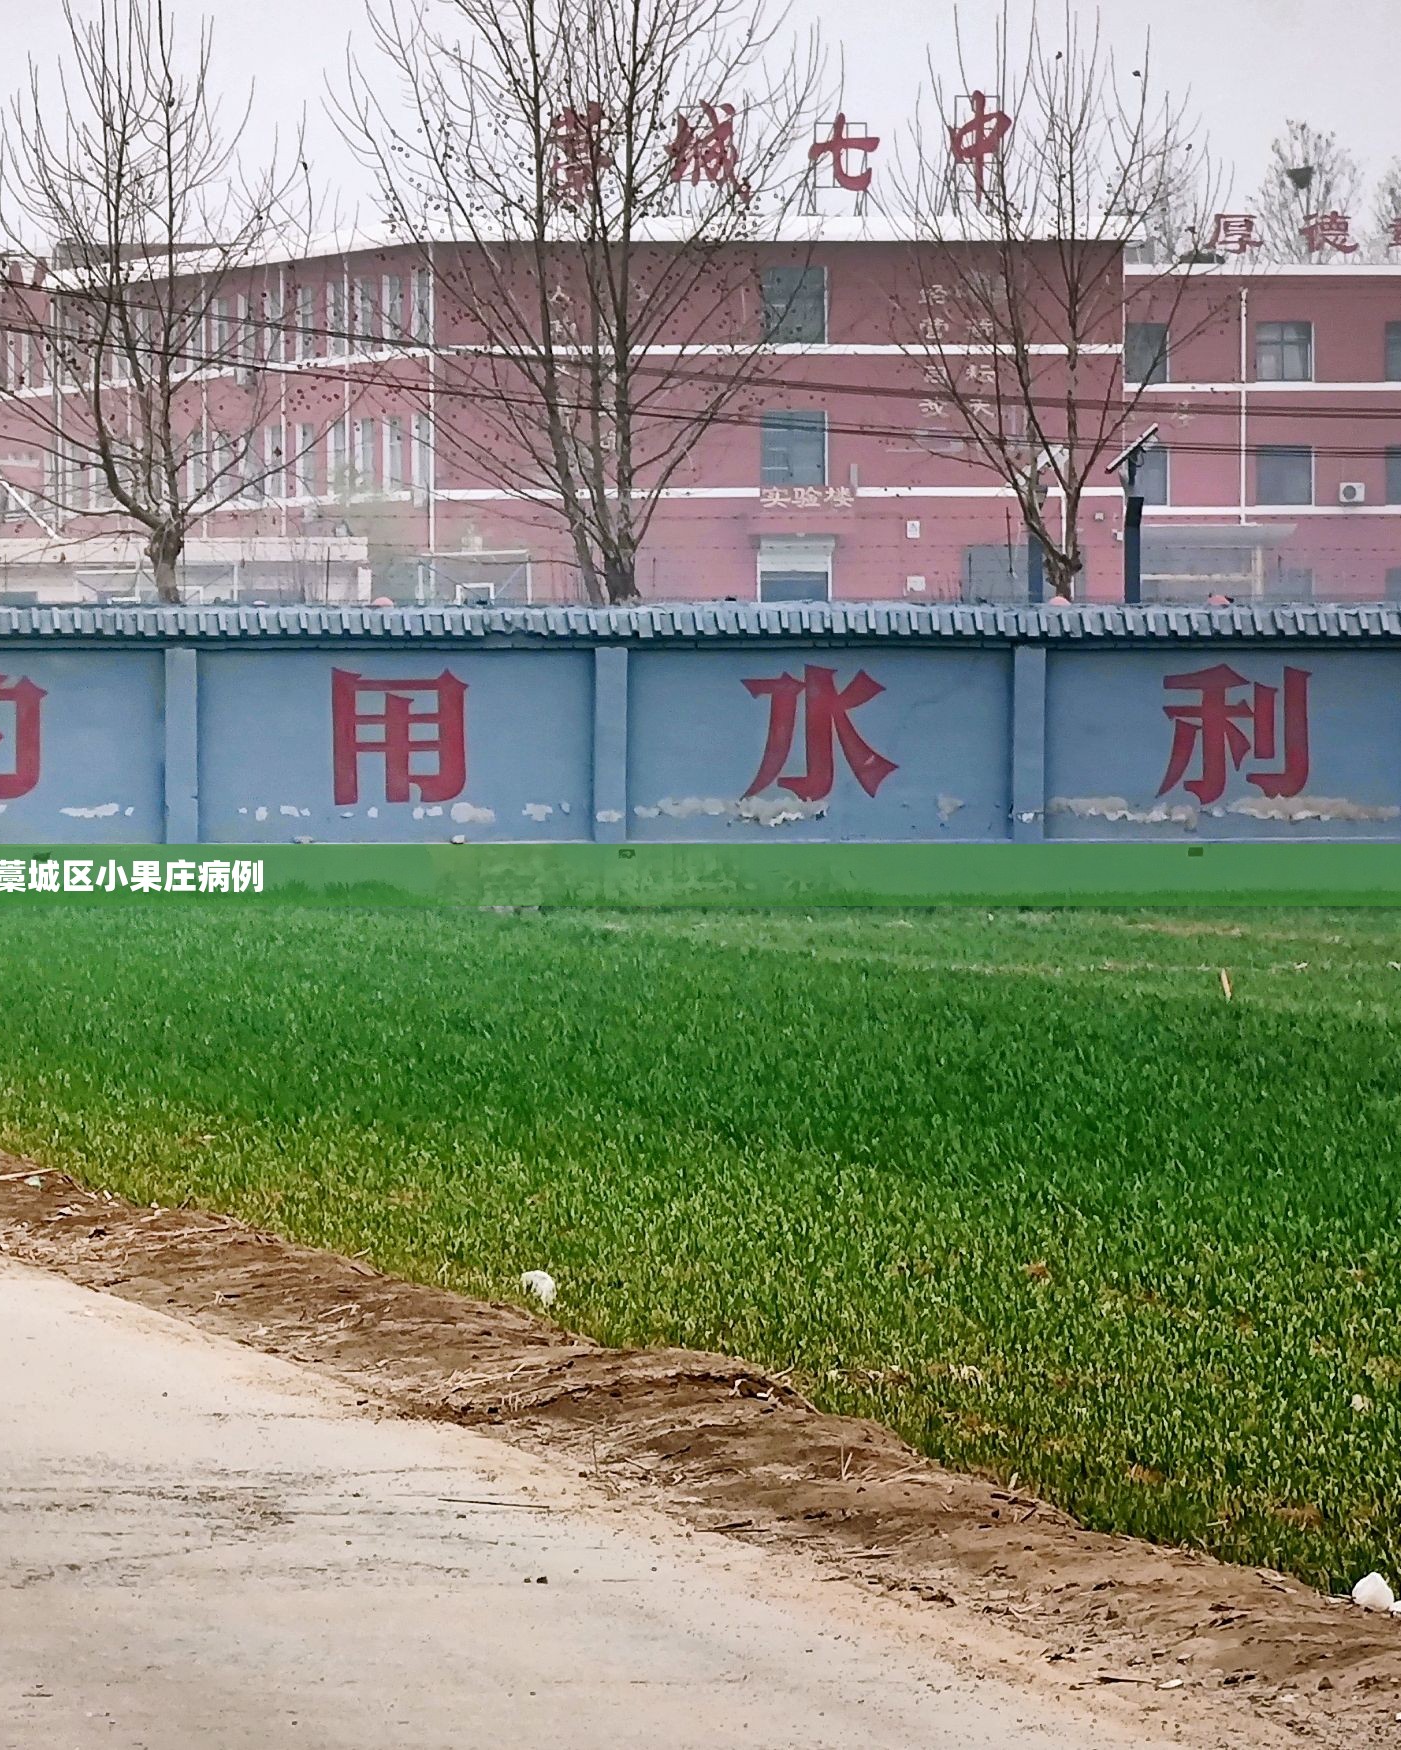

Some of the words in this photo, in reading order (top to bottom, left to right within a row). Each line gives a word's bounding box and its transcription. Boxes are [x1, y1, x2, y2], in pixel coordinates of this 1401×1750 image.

[1206, 210, 1401, 254] 厚德
[760, 486, 854, 508] 实验楼
